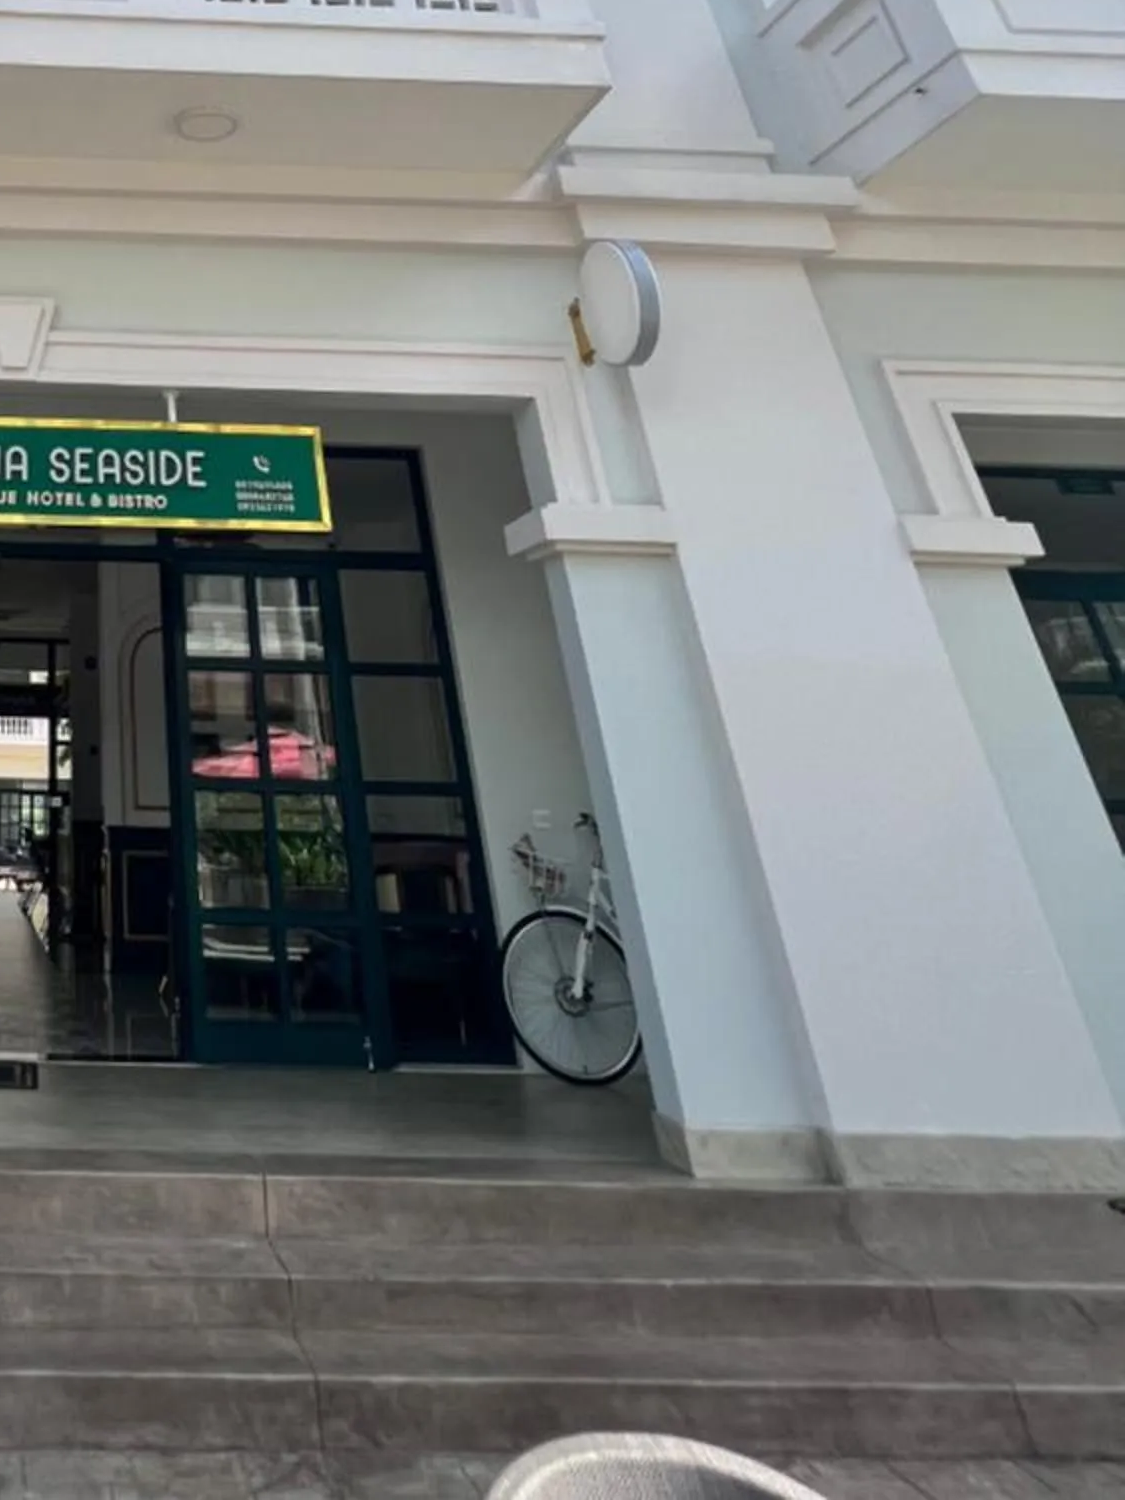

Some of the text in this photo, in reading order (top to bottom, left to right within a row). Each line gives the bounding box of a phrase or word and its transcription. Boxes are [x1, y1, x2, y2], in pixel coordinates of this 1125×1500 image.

[48, 446, 208, 488] SEASIDE
[26, 490, 85, 508] HOTEL
[89, 492, 103, 509] &
[108, 493, 168, 510] BISTRO
